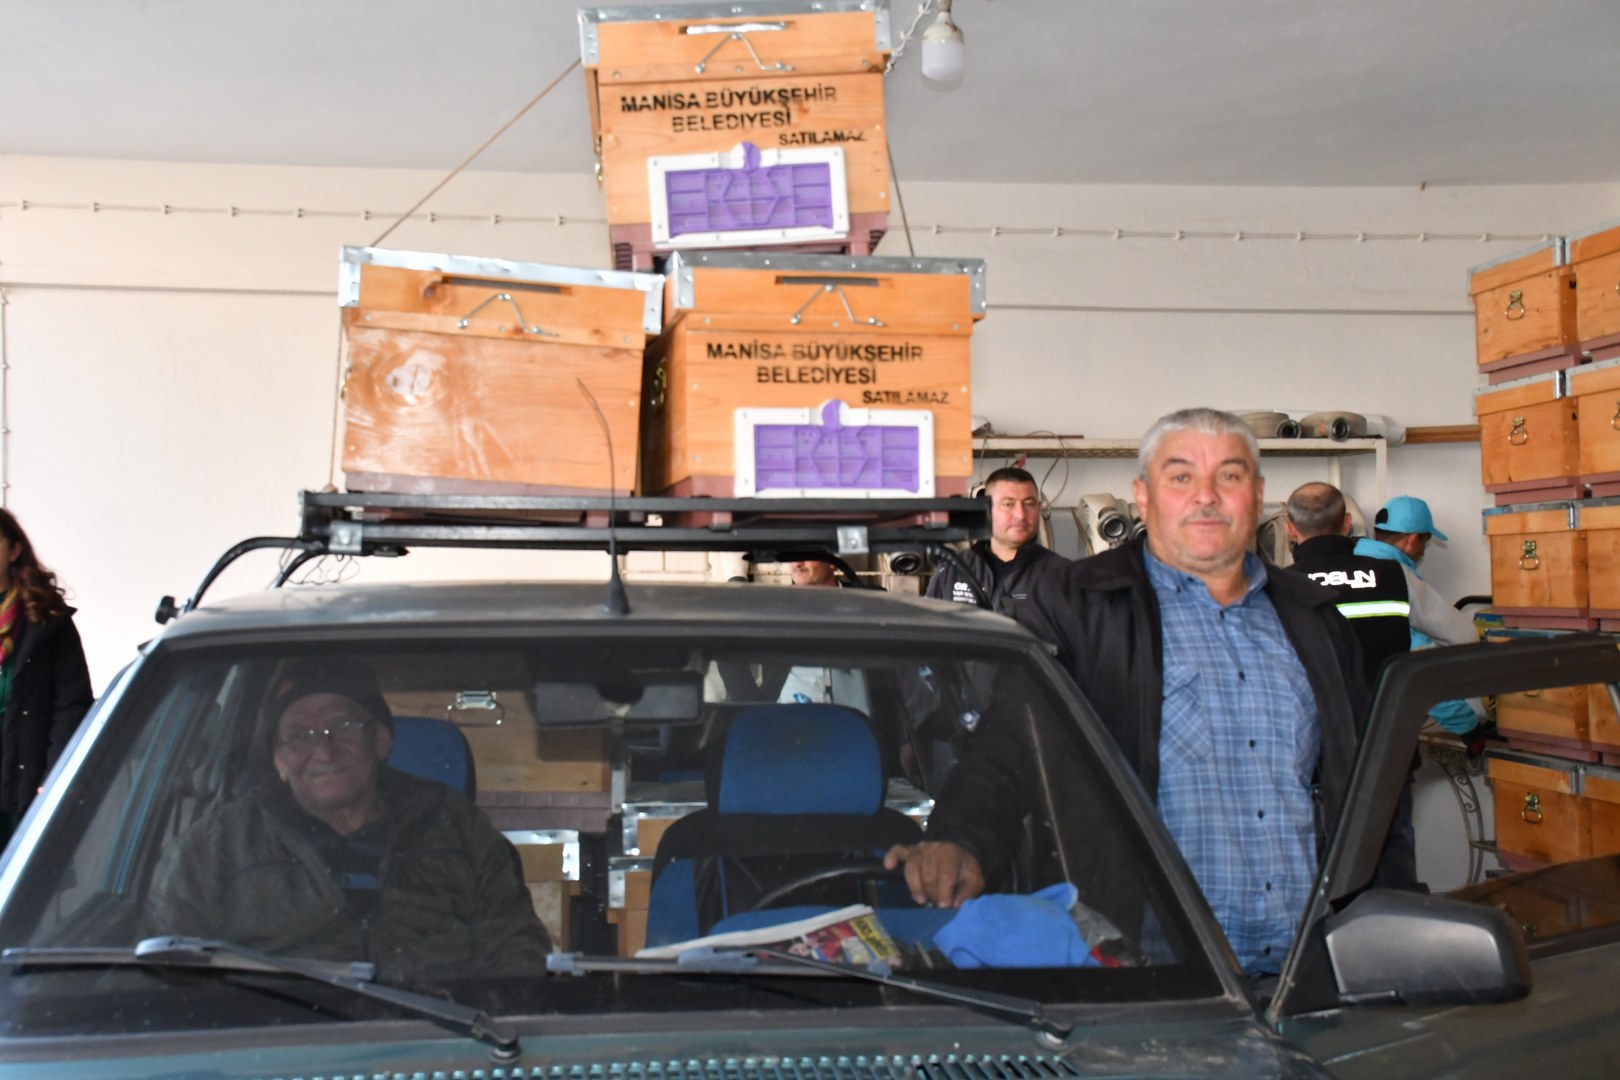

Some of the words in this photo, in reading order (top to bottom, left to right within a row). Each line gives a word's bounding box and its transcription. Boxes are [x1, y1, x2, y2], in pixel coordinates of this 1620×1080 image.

[706, 83, 838, 109] BÜYÜKŞEHİR
[706, 339, 786, 360] MANİSA
[792, 340, 924, 363] BÜYÜKŞEHİR
[757, 363, 876, 384] BELEDİYESİ
[862, 390, 950, 404] SATILAMAZ
